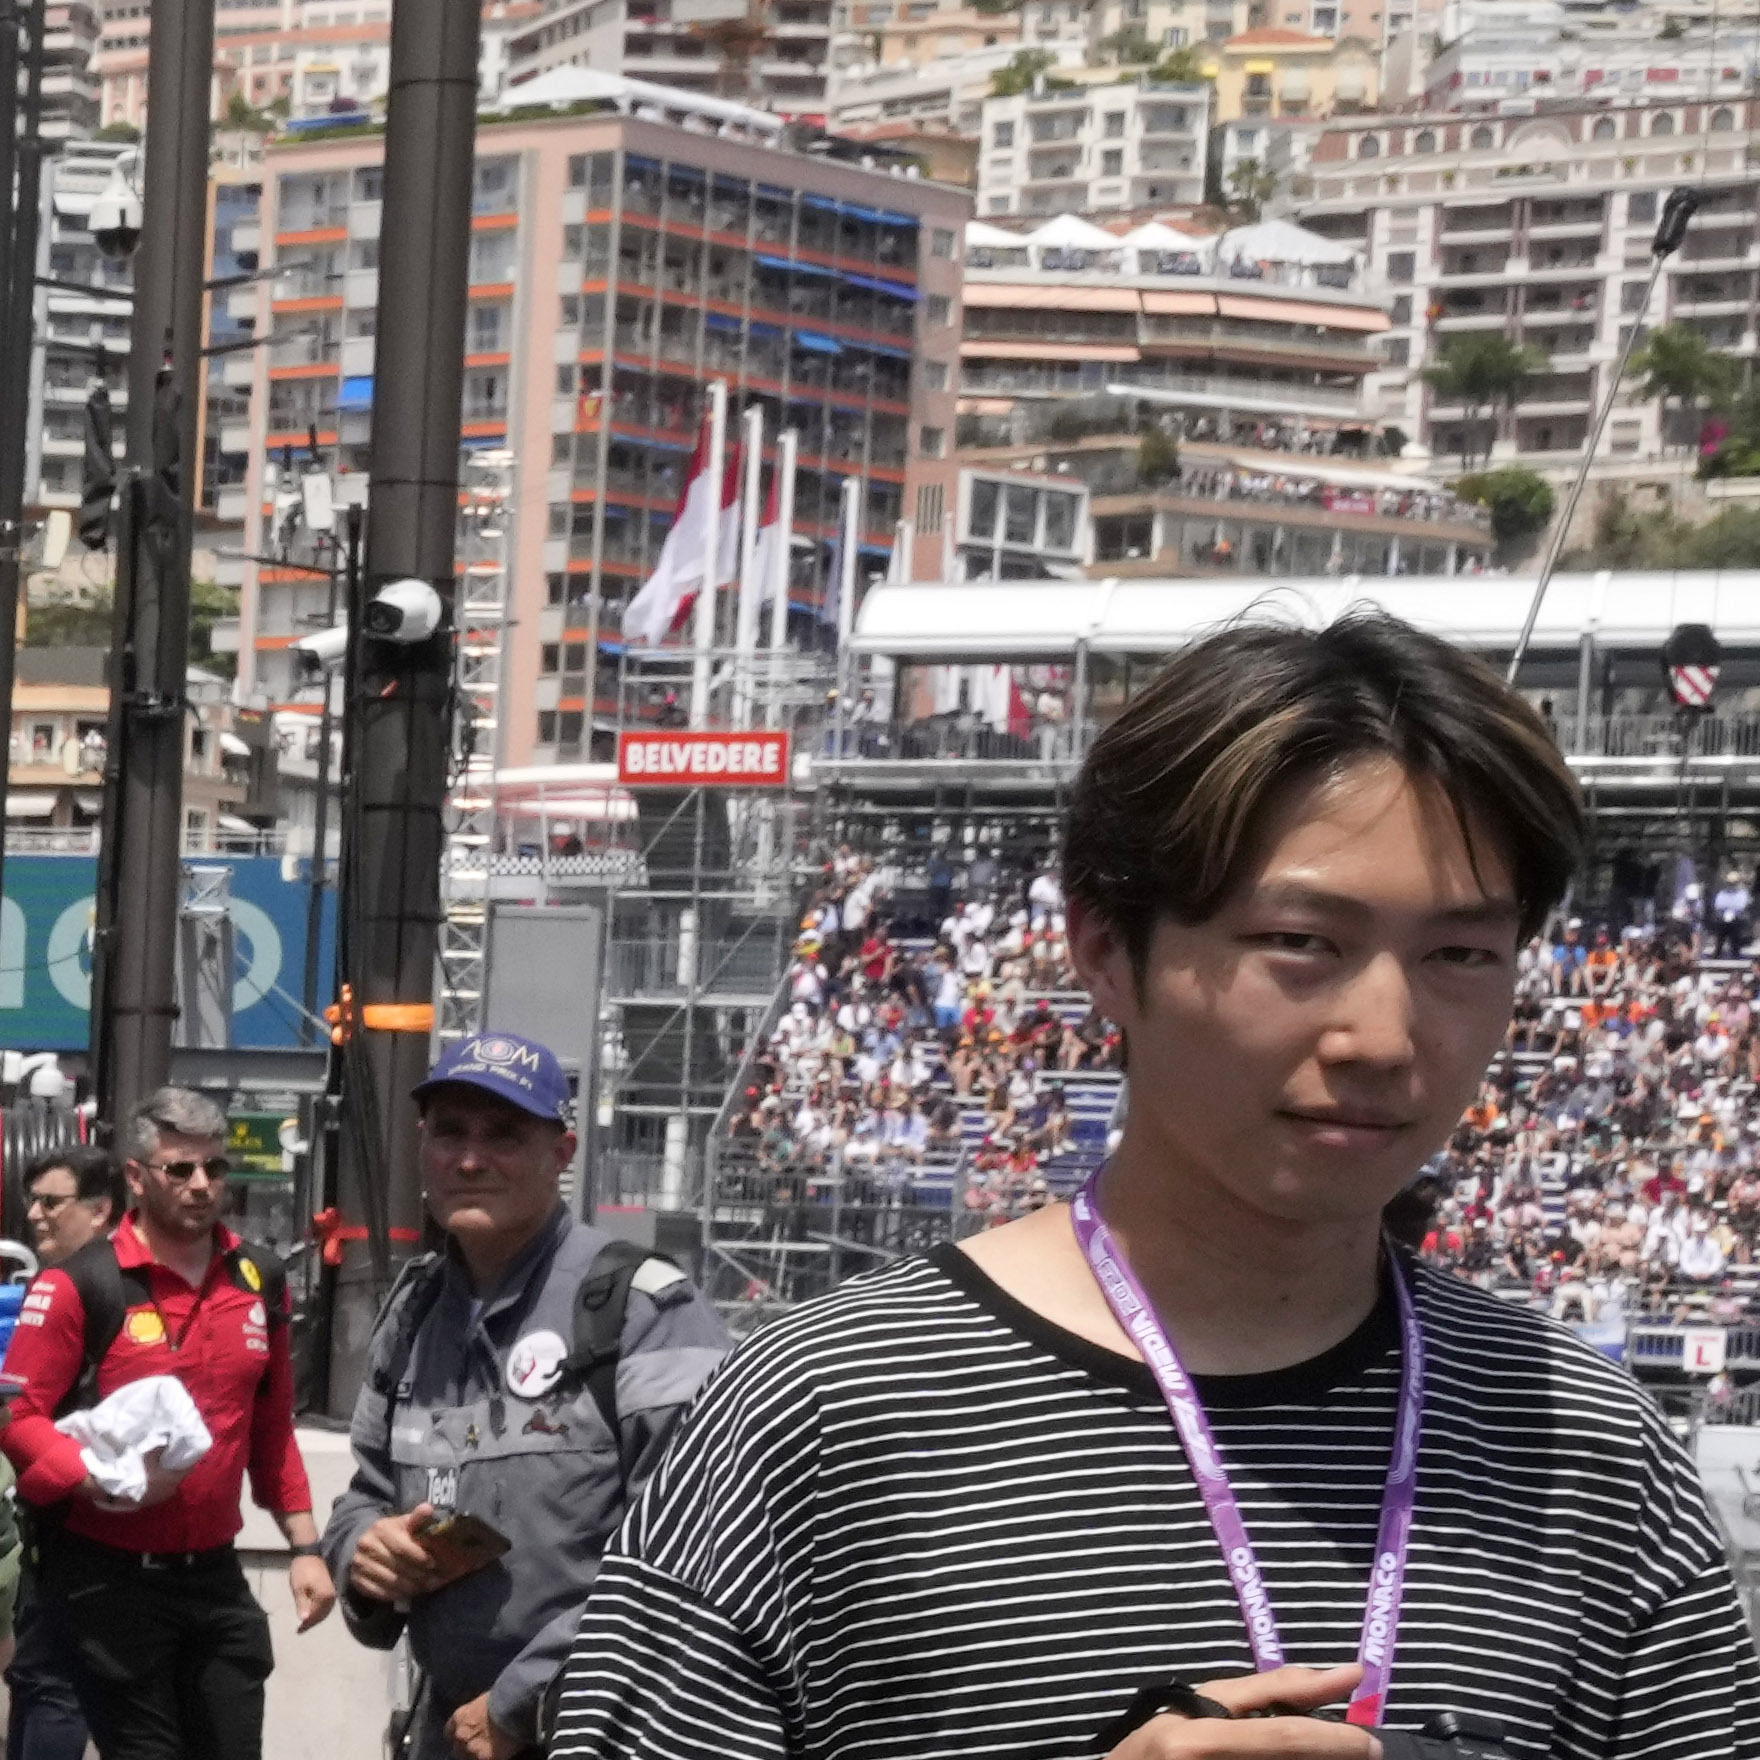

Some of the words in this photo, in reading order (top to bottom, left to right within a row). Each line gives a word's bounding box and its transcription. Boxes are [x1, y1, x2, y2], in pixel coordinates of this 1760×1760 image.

[626, 742, 780, 774] BELVEDERE
[426, 1467, 457, 1508] Tech
[1230, 1545, 1280, 1662] MONACO
[1364, 1550, 1398, 1667] MONACO
